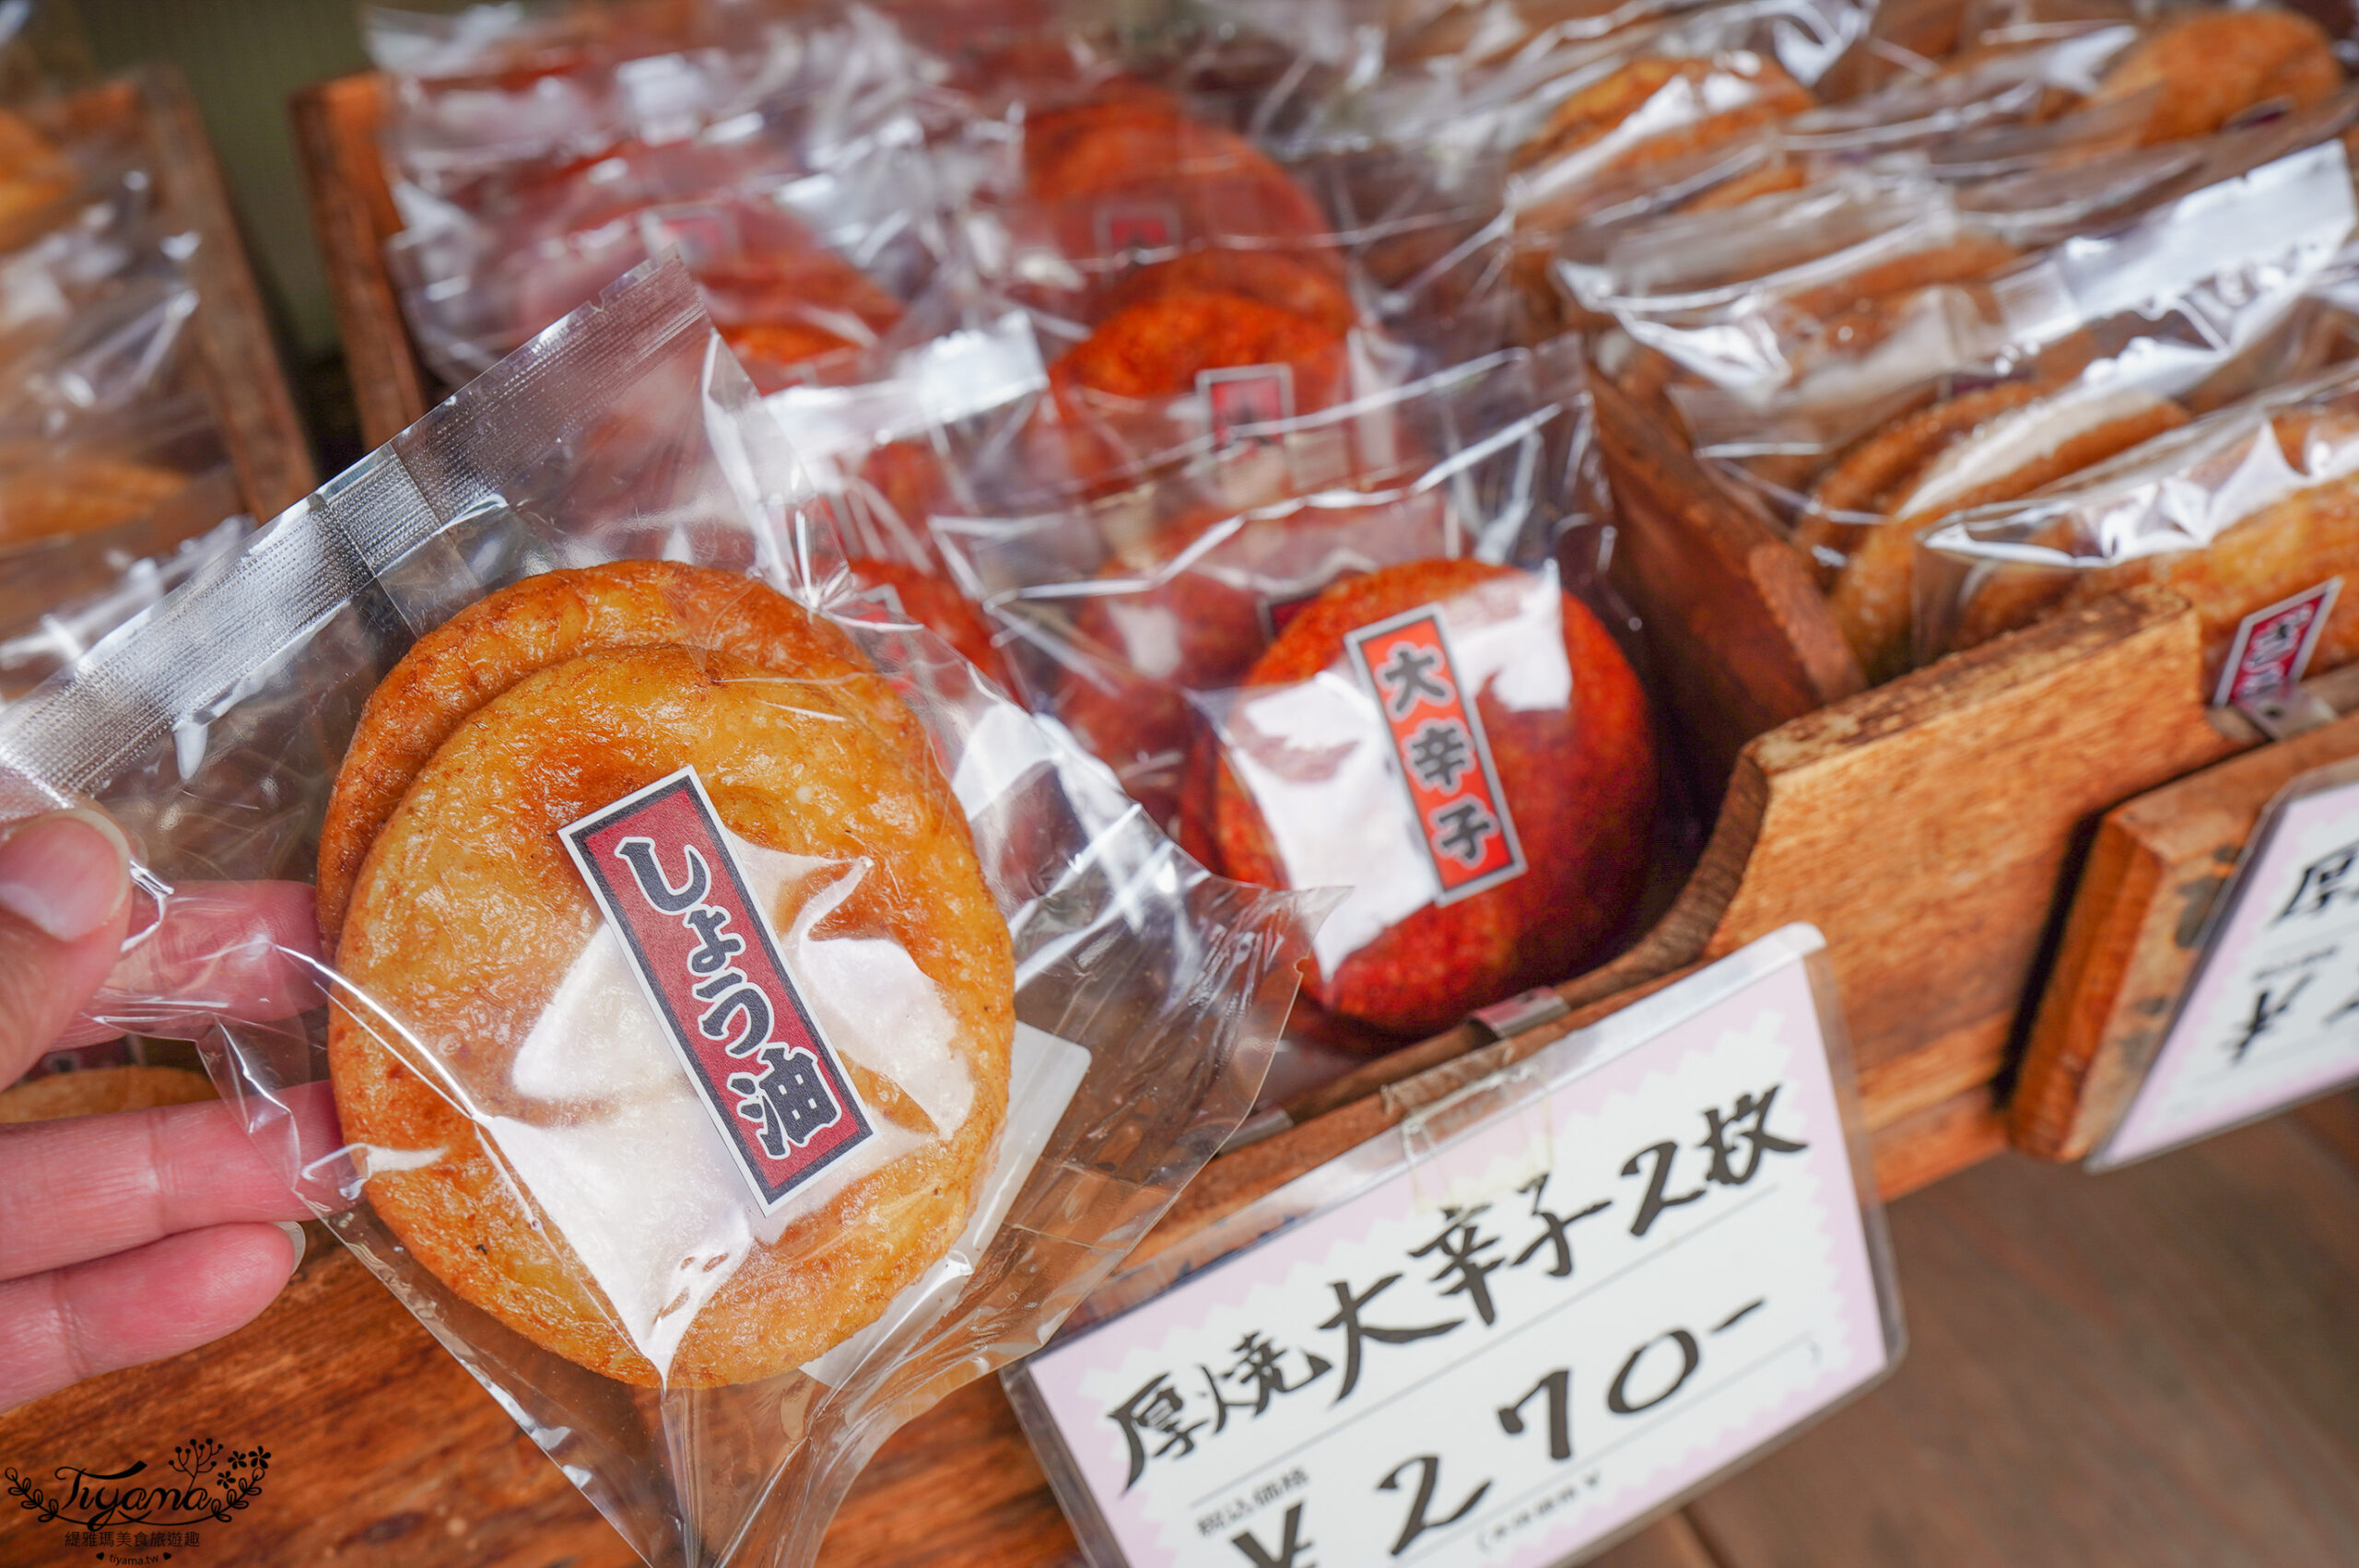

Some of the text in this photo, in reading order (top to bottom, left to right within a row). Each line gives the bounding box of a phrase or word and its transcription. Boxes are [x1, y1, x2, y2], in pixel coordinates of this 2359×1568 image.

[1379, 644, 1496, 866] 大辛子
[613, 836, 842, 1160] しょう油
